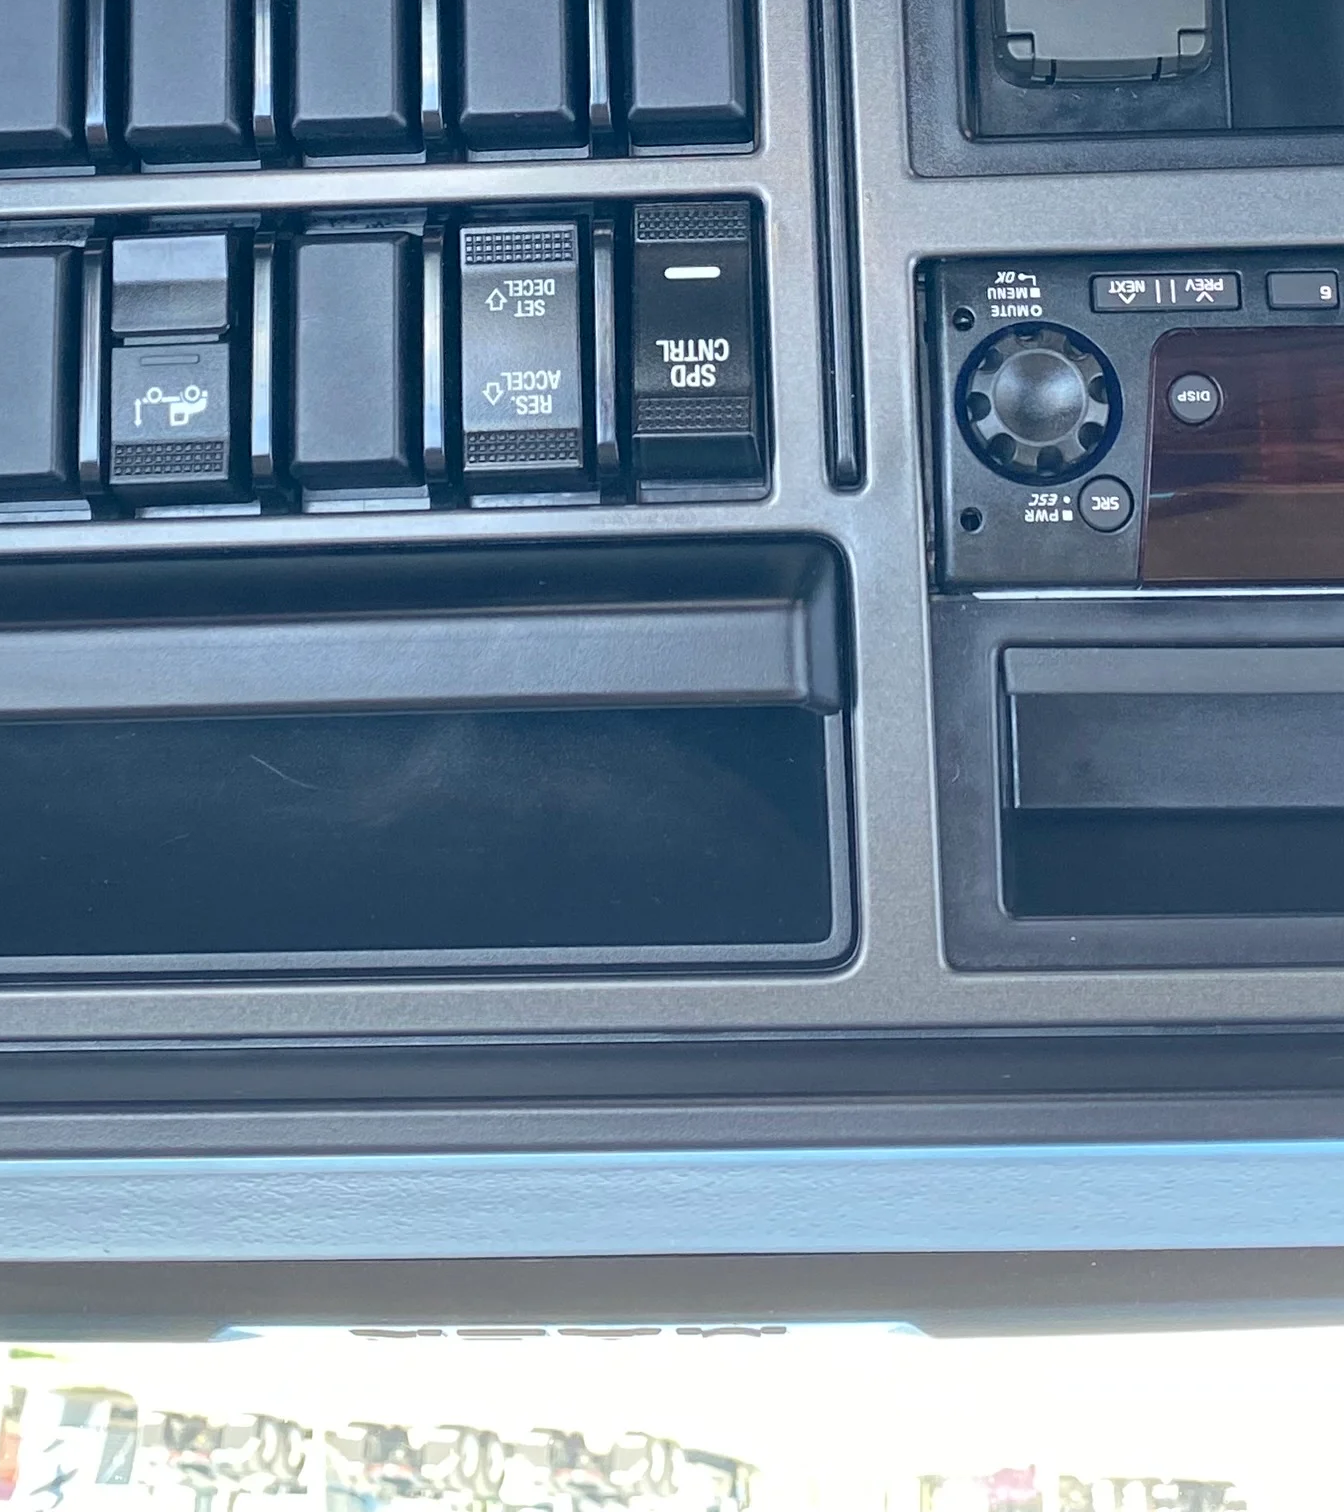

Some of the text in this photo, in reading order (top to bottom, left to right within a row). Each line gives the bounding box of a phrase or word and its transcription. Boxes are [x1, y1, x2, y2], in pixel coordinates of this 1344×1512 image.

[994, 272, 1016, 284] OK
[1184, 278, 1224, 292] PREV
[504, 278, 556, 297] DECEL
[987, 287, 1028, 300] MENU
[1108, 280, 1146, 294] NEXT
[1320, 285, 1332, 299] 6
[513, 299, 546, 317] SET
[991, 305, 1029, 317] MUTE
[656, 338, 729, 362] CNTRL
[500, 370, 561, 390] ACCEL
[670, 363, 716, 388] SPD
[1177, 390, 1210, 402] DISP
[510, 394, 552, 414] RES.
[1028, 493, 1058, 506] ESC
[1092, 496, 1119, 510] SRC
[1024, 509, 1059, 522] PWR
